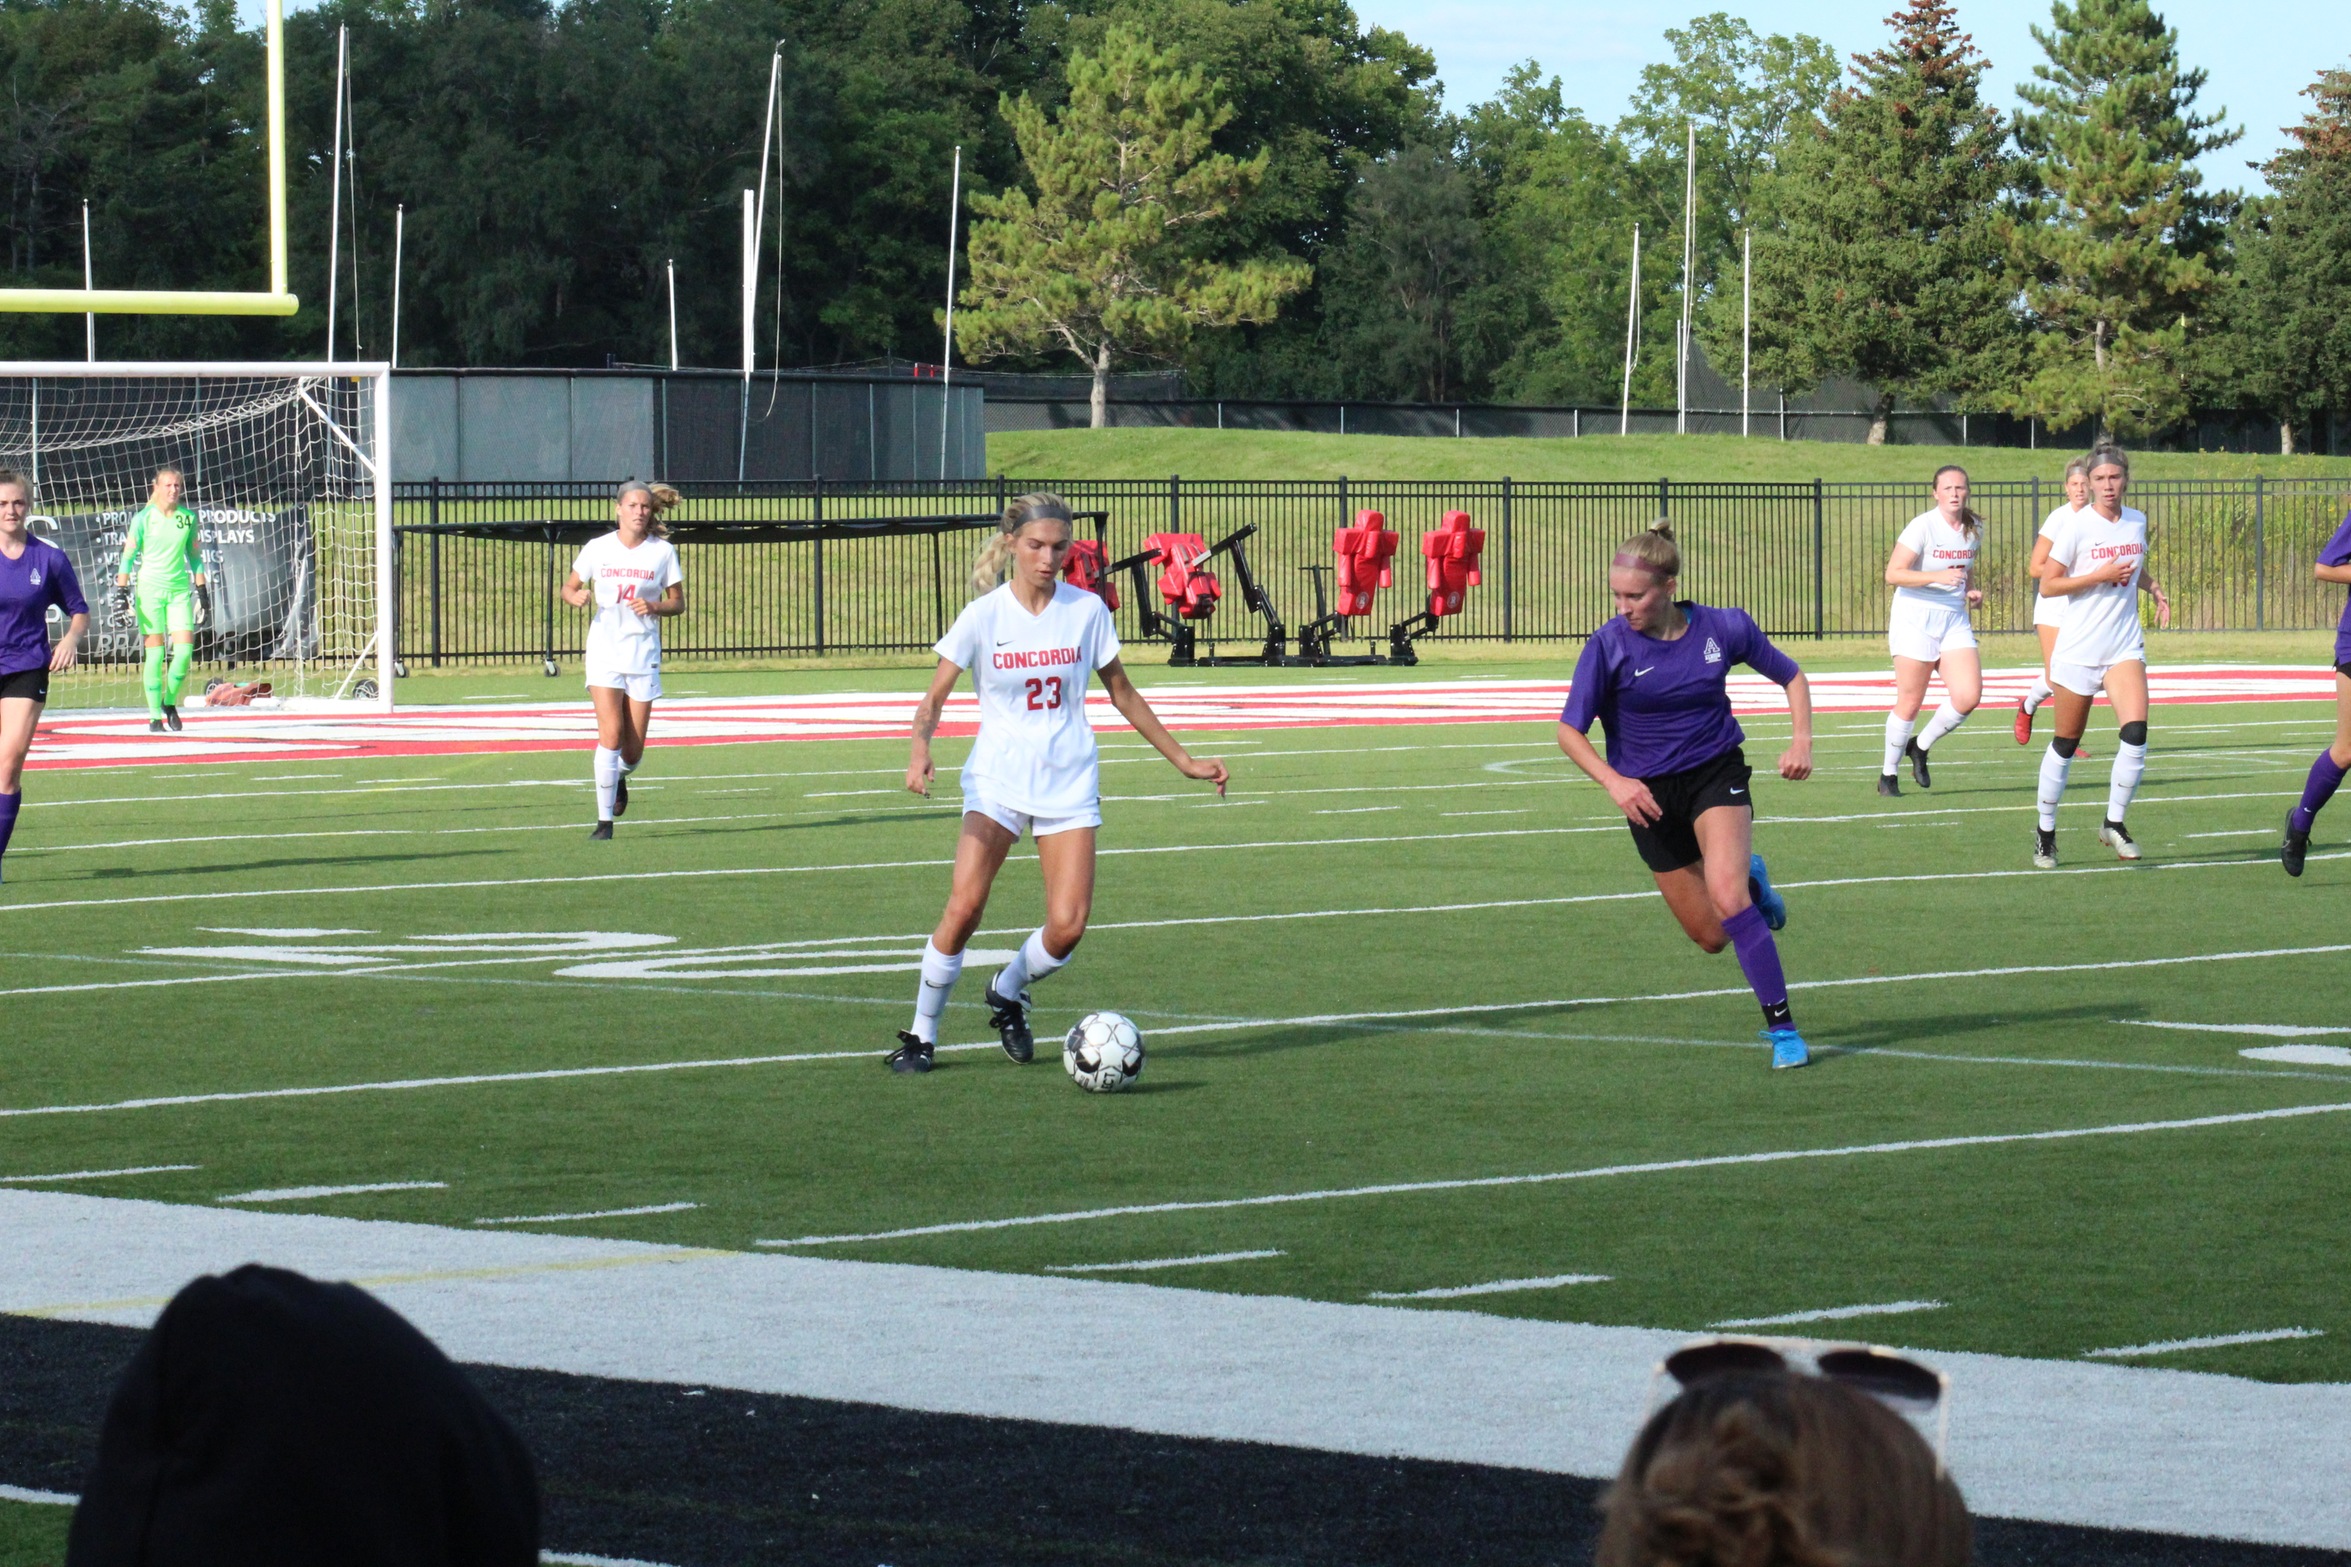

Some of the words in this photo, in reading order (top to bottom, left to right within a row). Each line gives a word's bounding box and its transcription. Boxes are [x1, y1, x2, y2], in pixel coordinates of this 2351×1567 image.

[176, 515, 192, 529] 34
[600, 568, 655, 580] CONCORDIA
[616, 583, 637, 604] 14
[993, 646, 1082, 669] CONCORDIA
[1025, 676, 1062, 711] 23
